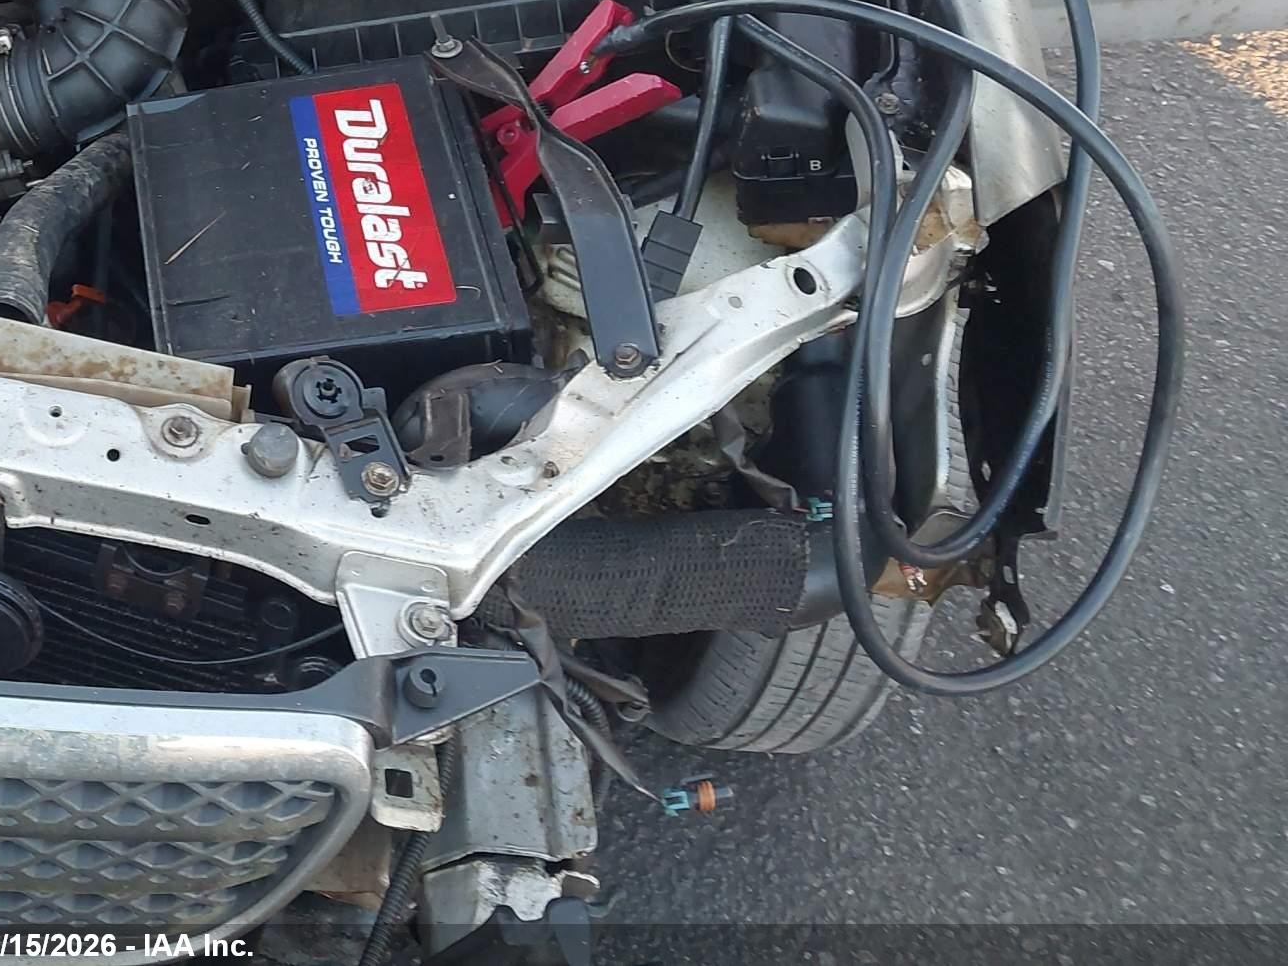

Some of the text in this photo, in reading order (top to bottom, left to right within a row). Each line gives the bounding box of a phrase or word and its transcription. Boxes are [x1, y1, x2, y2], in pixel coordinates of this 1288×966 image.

[303, 137, 343, 264] PROVEN TOUGH
[334, 99, 429, 289] Duralast
[809, 160, 822, 171] B
